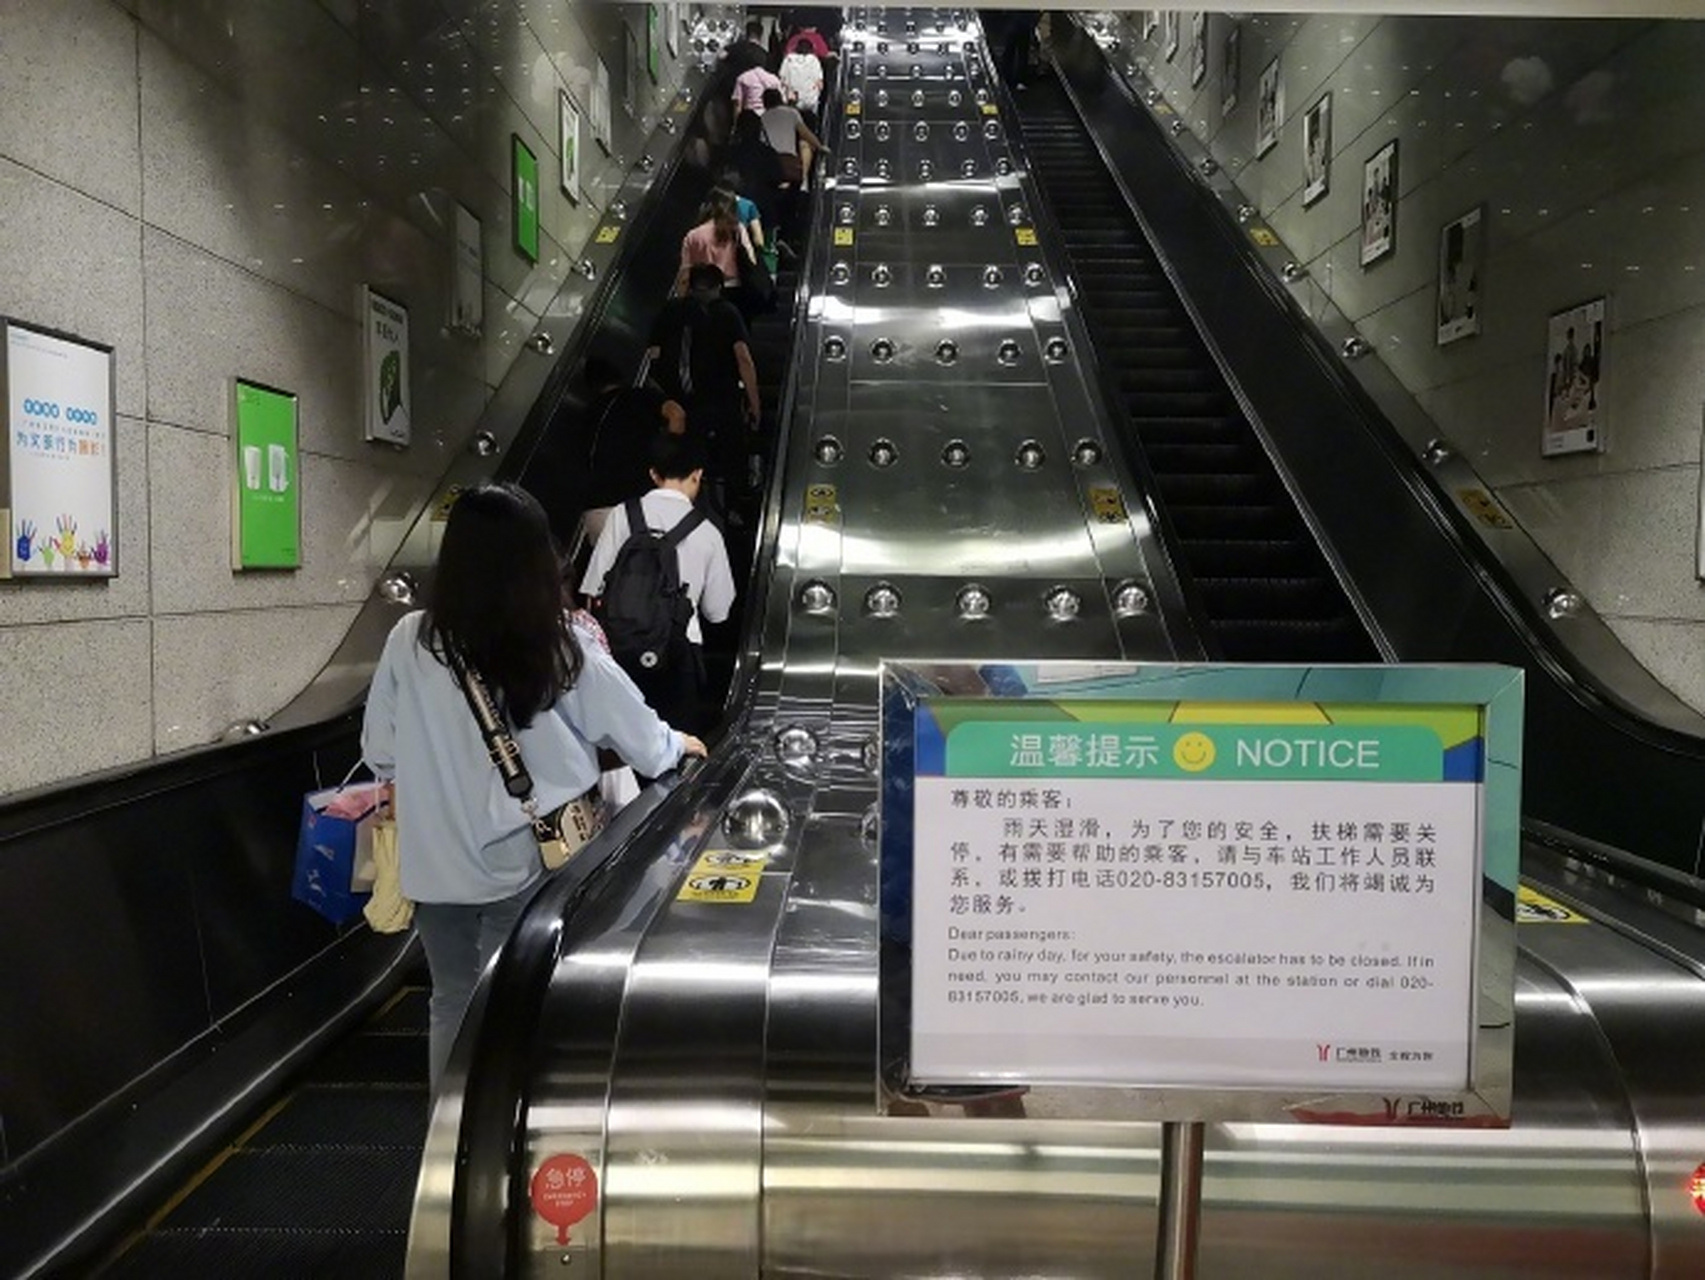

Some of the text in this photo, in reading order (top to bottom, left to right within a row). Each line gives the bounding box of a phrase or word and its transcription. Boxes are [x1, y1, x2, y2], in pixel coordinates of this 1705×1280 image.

[1010, 733, 1159, 768] 温馨提示
[1237, 738, 1380, 768] NOTICE
[948, 926, 1076, 942] Dear passengers:
[948, 948, 977, 961] Due
[980, 949, 994, 962] to
[998, 949, 1034, 964] rainy
[1072, 949, 1090, 962] for
[1093, 952, 1125, 964] your
[1180, 951, 1204, 964] the
[1207, 951, 1276, 965] escalator
[1279, 952, 1306, 965] has
[1311, 953, 1325, 965] to
[1328, 953, 1346, 966] be
[1407, 955, 1420, 967] If
[1421, 955, 1434, 967] in
[995, 971, 1021, 983] you
[1027, 972, 1058, 984] may
[1064, 970, 1118, 983] contact
[1124, 972, 1148, 983] our
[1155, 973, 1229, 986] personnel
[1235, 973, 1249, 985] at
[1257, 973, 1280, 986] the
[1287, 974, 1337, 987] station
[1344, 976, 1359, 987] or
[1366, 974, 1394, 988] dial
[1400, 975, 1434, 988] 020-
[1027, 993, 1046, 1003] we
[1051, 993, 1075, 1004] are
[1077, 991, 1108, 1007] glad
[1112, 992, 1126, 1004] to
[1129, 993, 1169, 1005] serve
[545, 1167, 587, 1190] 急停
